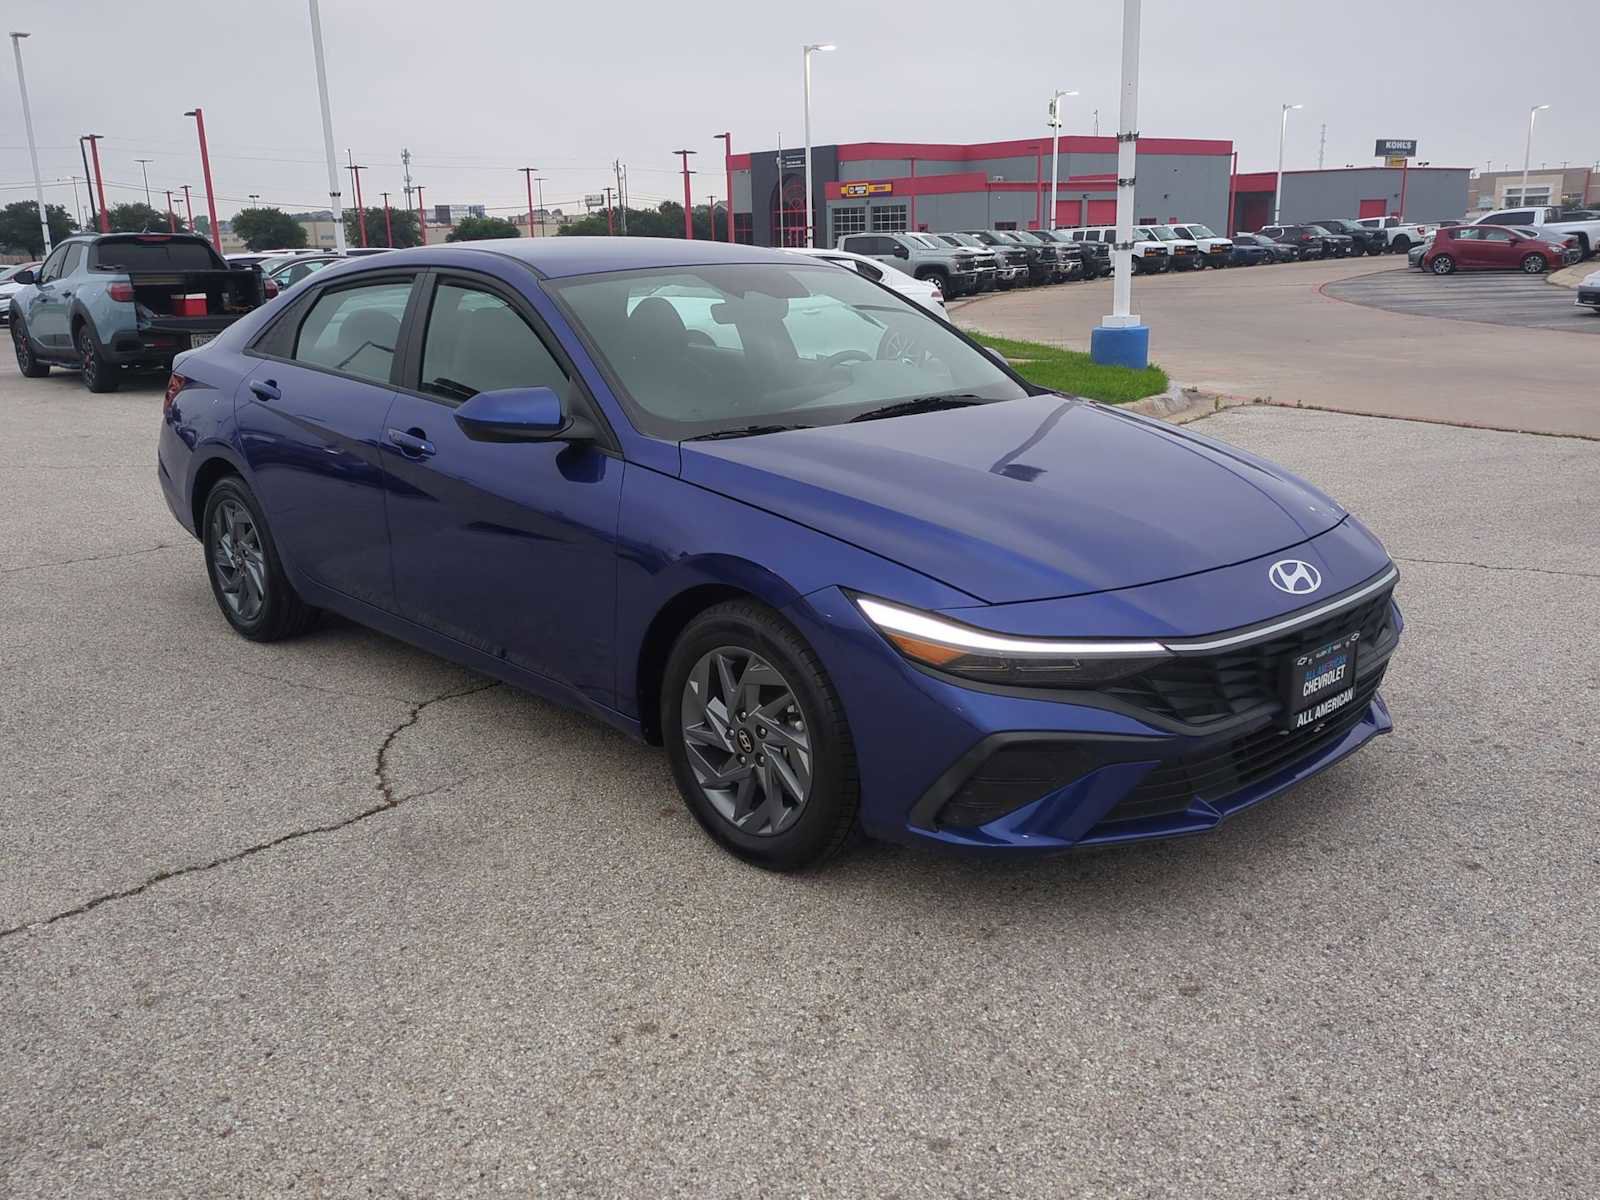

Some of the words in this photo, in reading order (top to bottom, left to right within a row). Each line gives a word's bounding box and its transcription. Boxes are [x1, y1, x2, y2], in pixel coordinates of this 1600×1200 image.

[1303, 664, 1346, 696] CHEVROLET
[1297, 709, 1314, 728] ALL
[1314, 688, 1354, 720] AMERICAN
